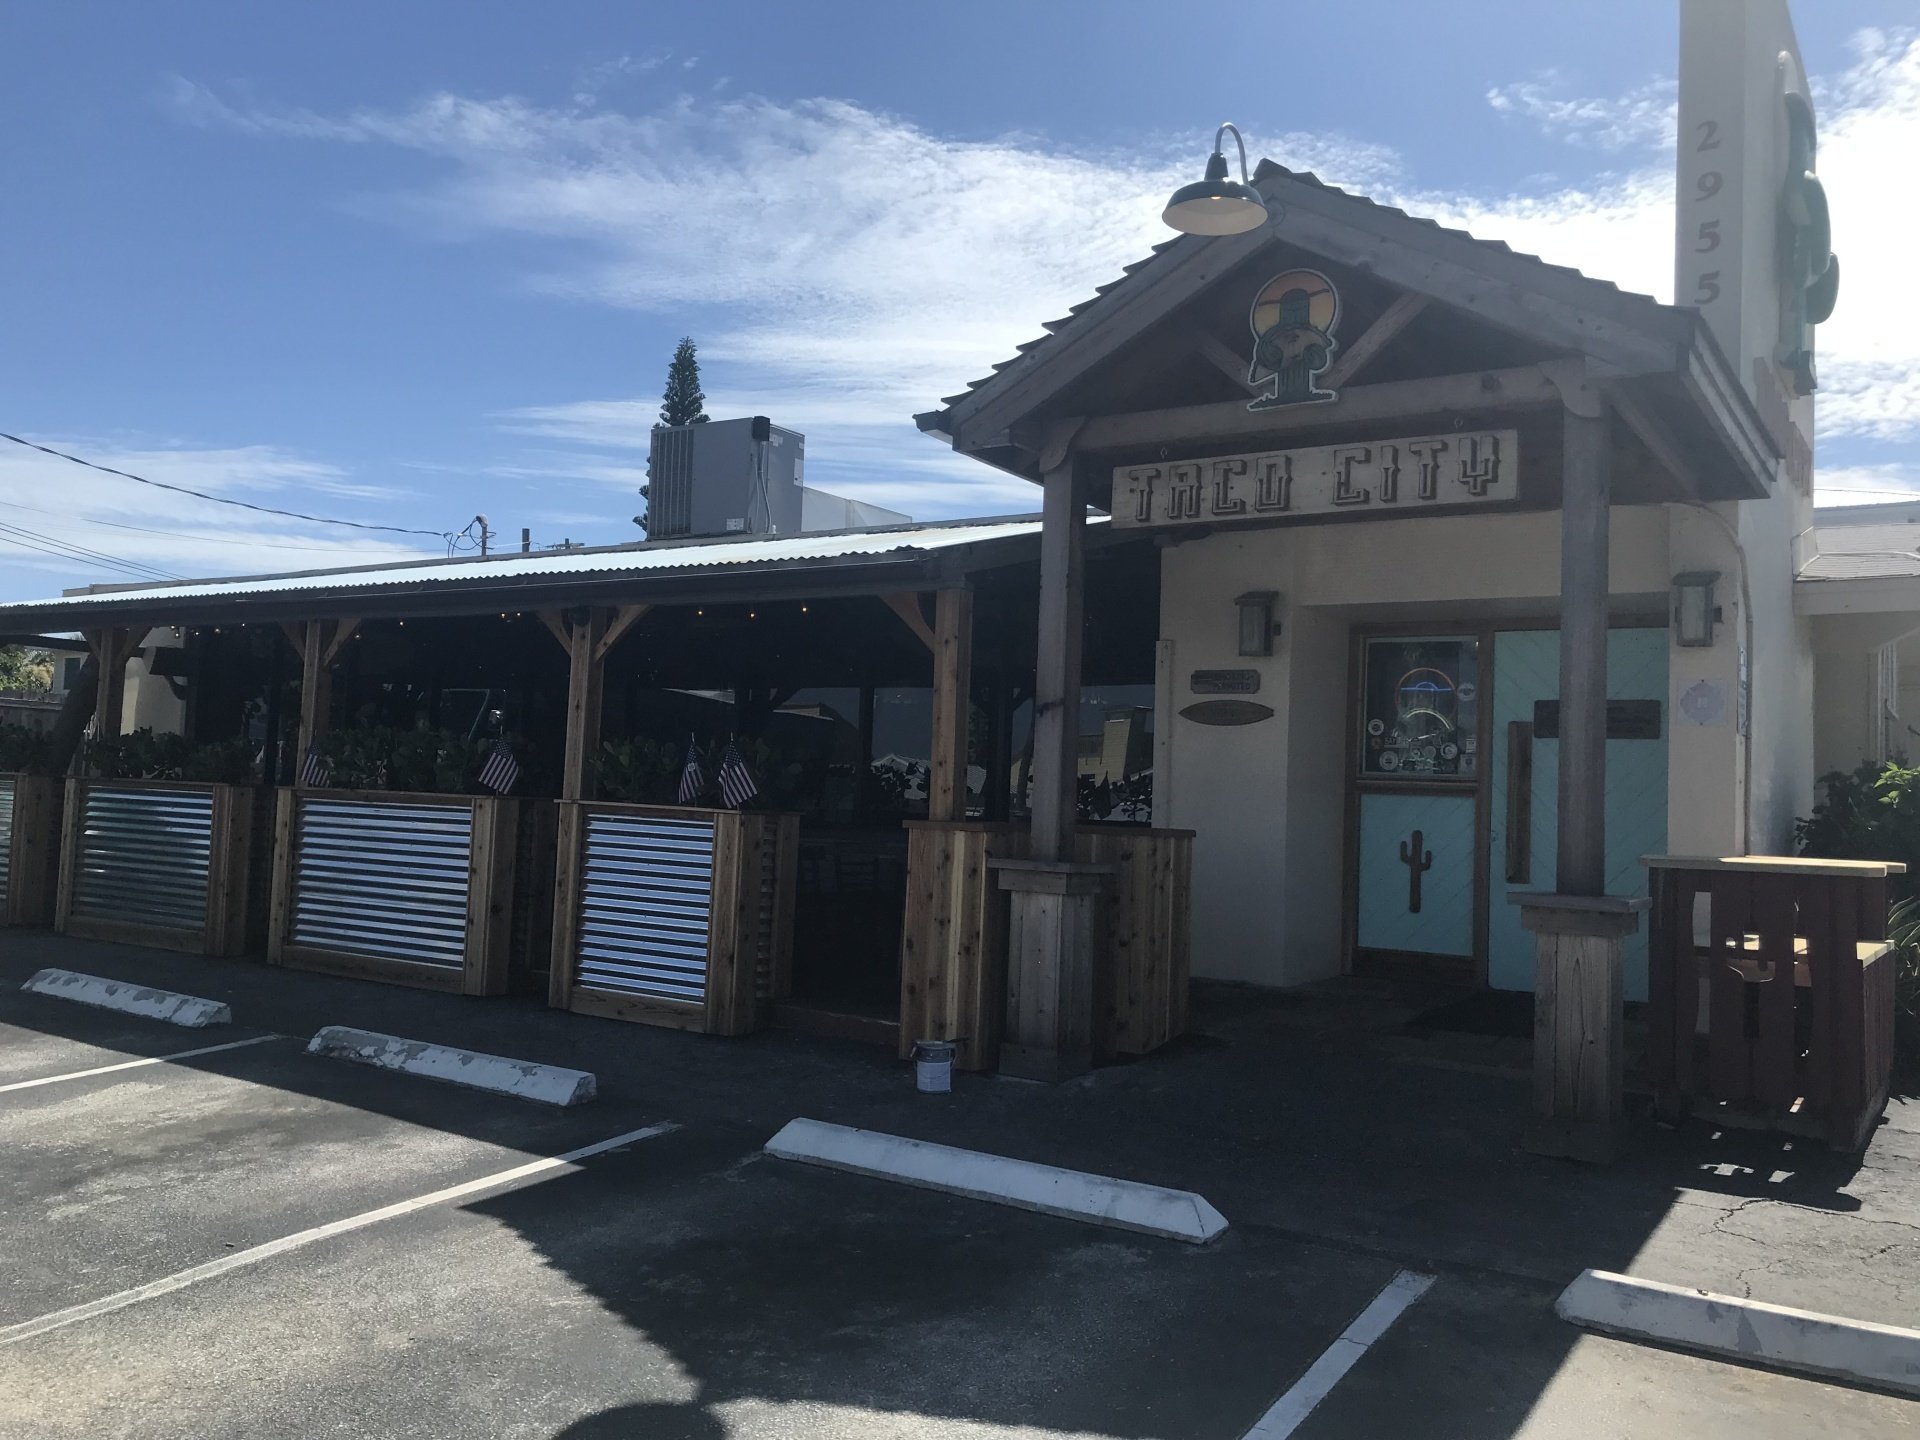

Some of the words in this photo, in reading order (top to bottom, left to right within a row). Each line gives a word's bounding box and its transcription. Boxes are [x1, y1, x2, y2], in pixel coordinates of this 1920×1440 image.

[1694, 119, 1723, 305] 2955
[1129, 455, 1293, 524] TACO
[1331, 434, 1501, 506] CITY
